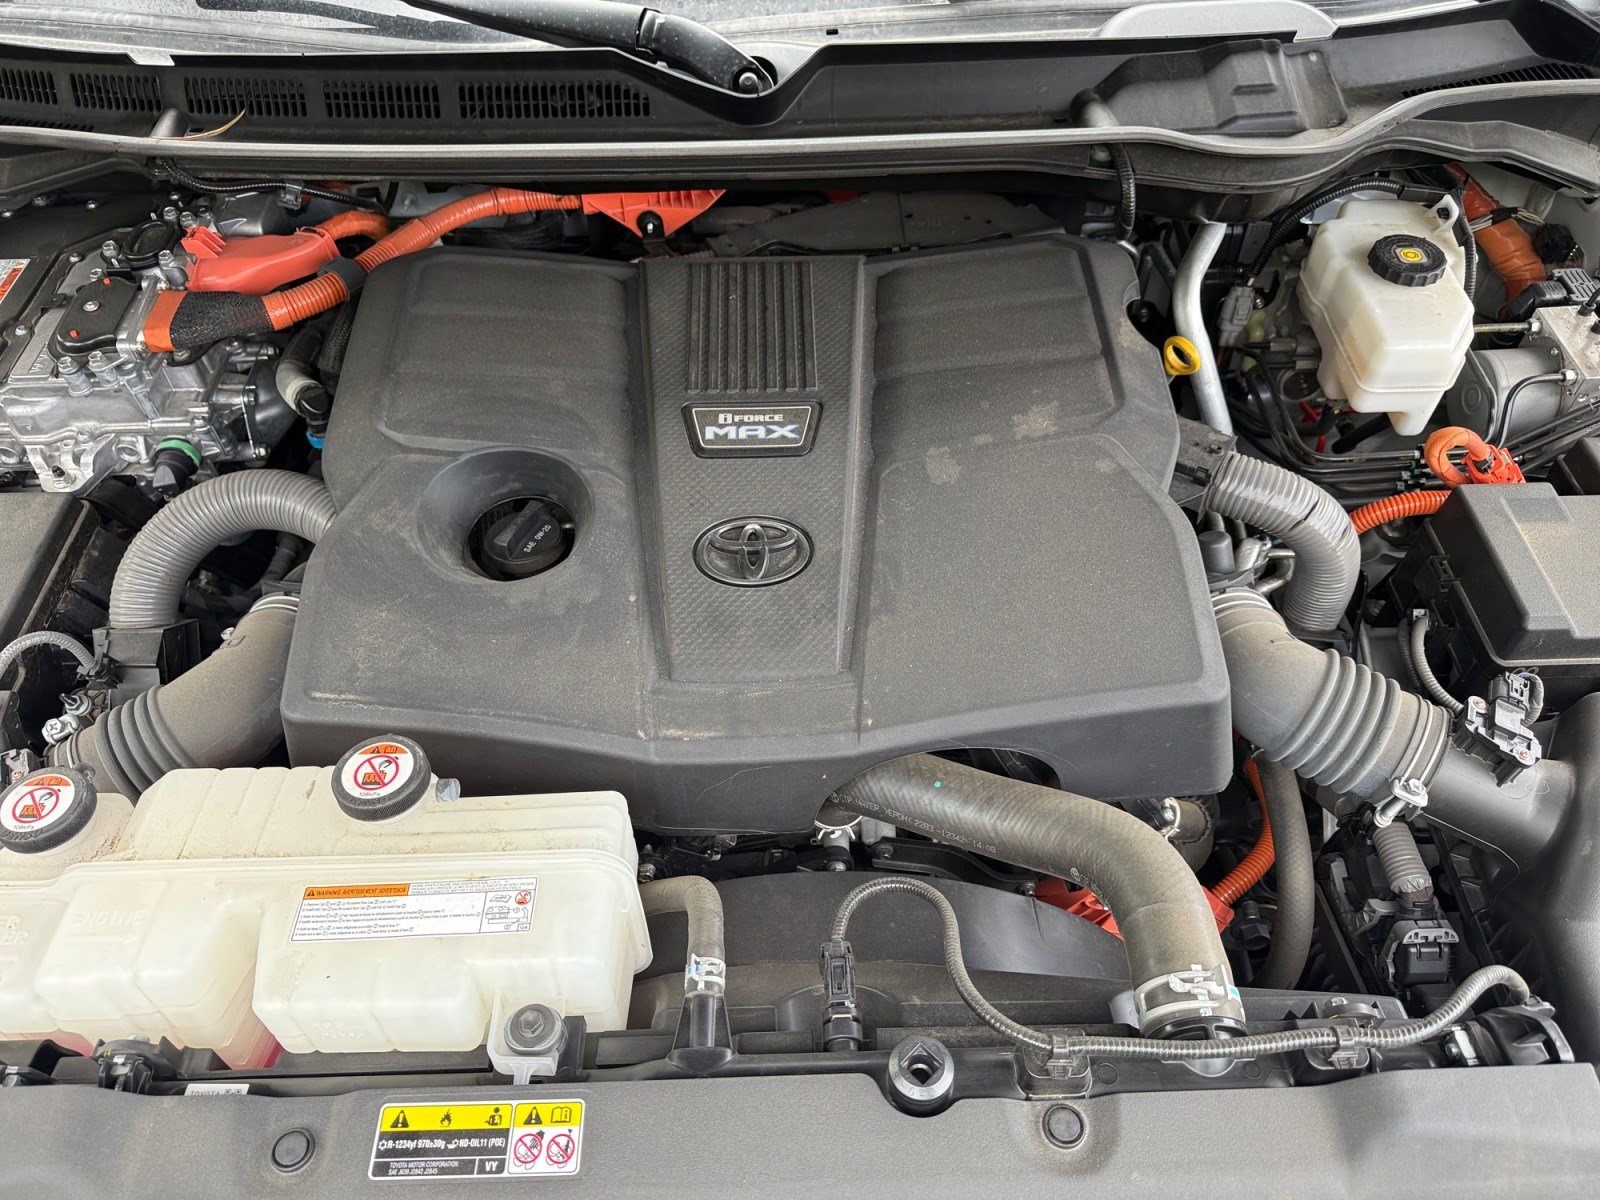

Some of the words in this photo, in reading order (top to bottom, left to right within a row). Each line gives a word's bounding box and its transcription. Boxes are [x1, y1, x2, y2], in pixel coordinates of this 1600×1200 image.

[704, 424, 800, 440] MAX
[523, 541, 537, 553] SAE
[534, 524, 552, 541] 0W-20
[71, 910, 147, 925] ENGINE
[426, 1160, 459, 1168] CORPORATION
[485, 1161, 499, 1172] VY
